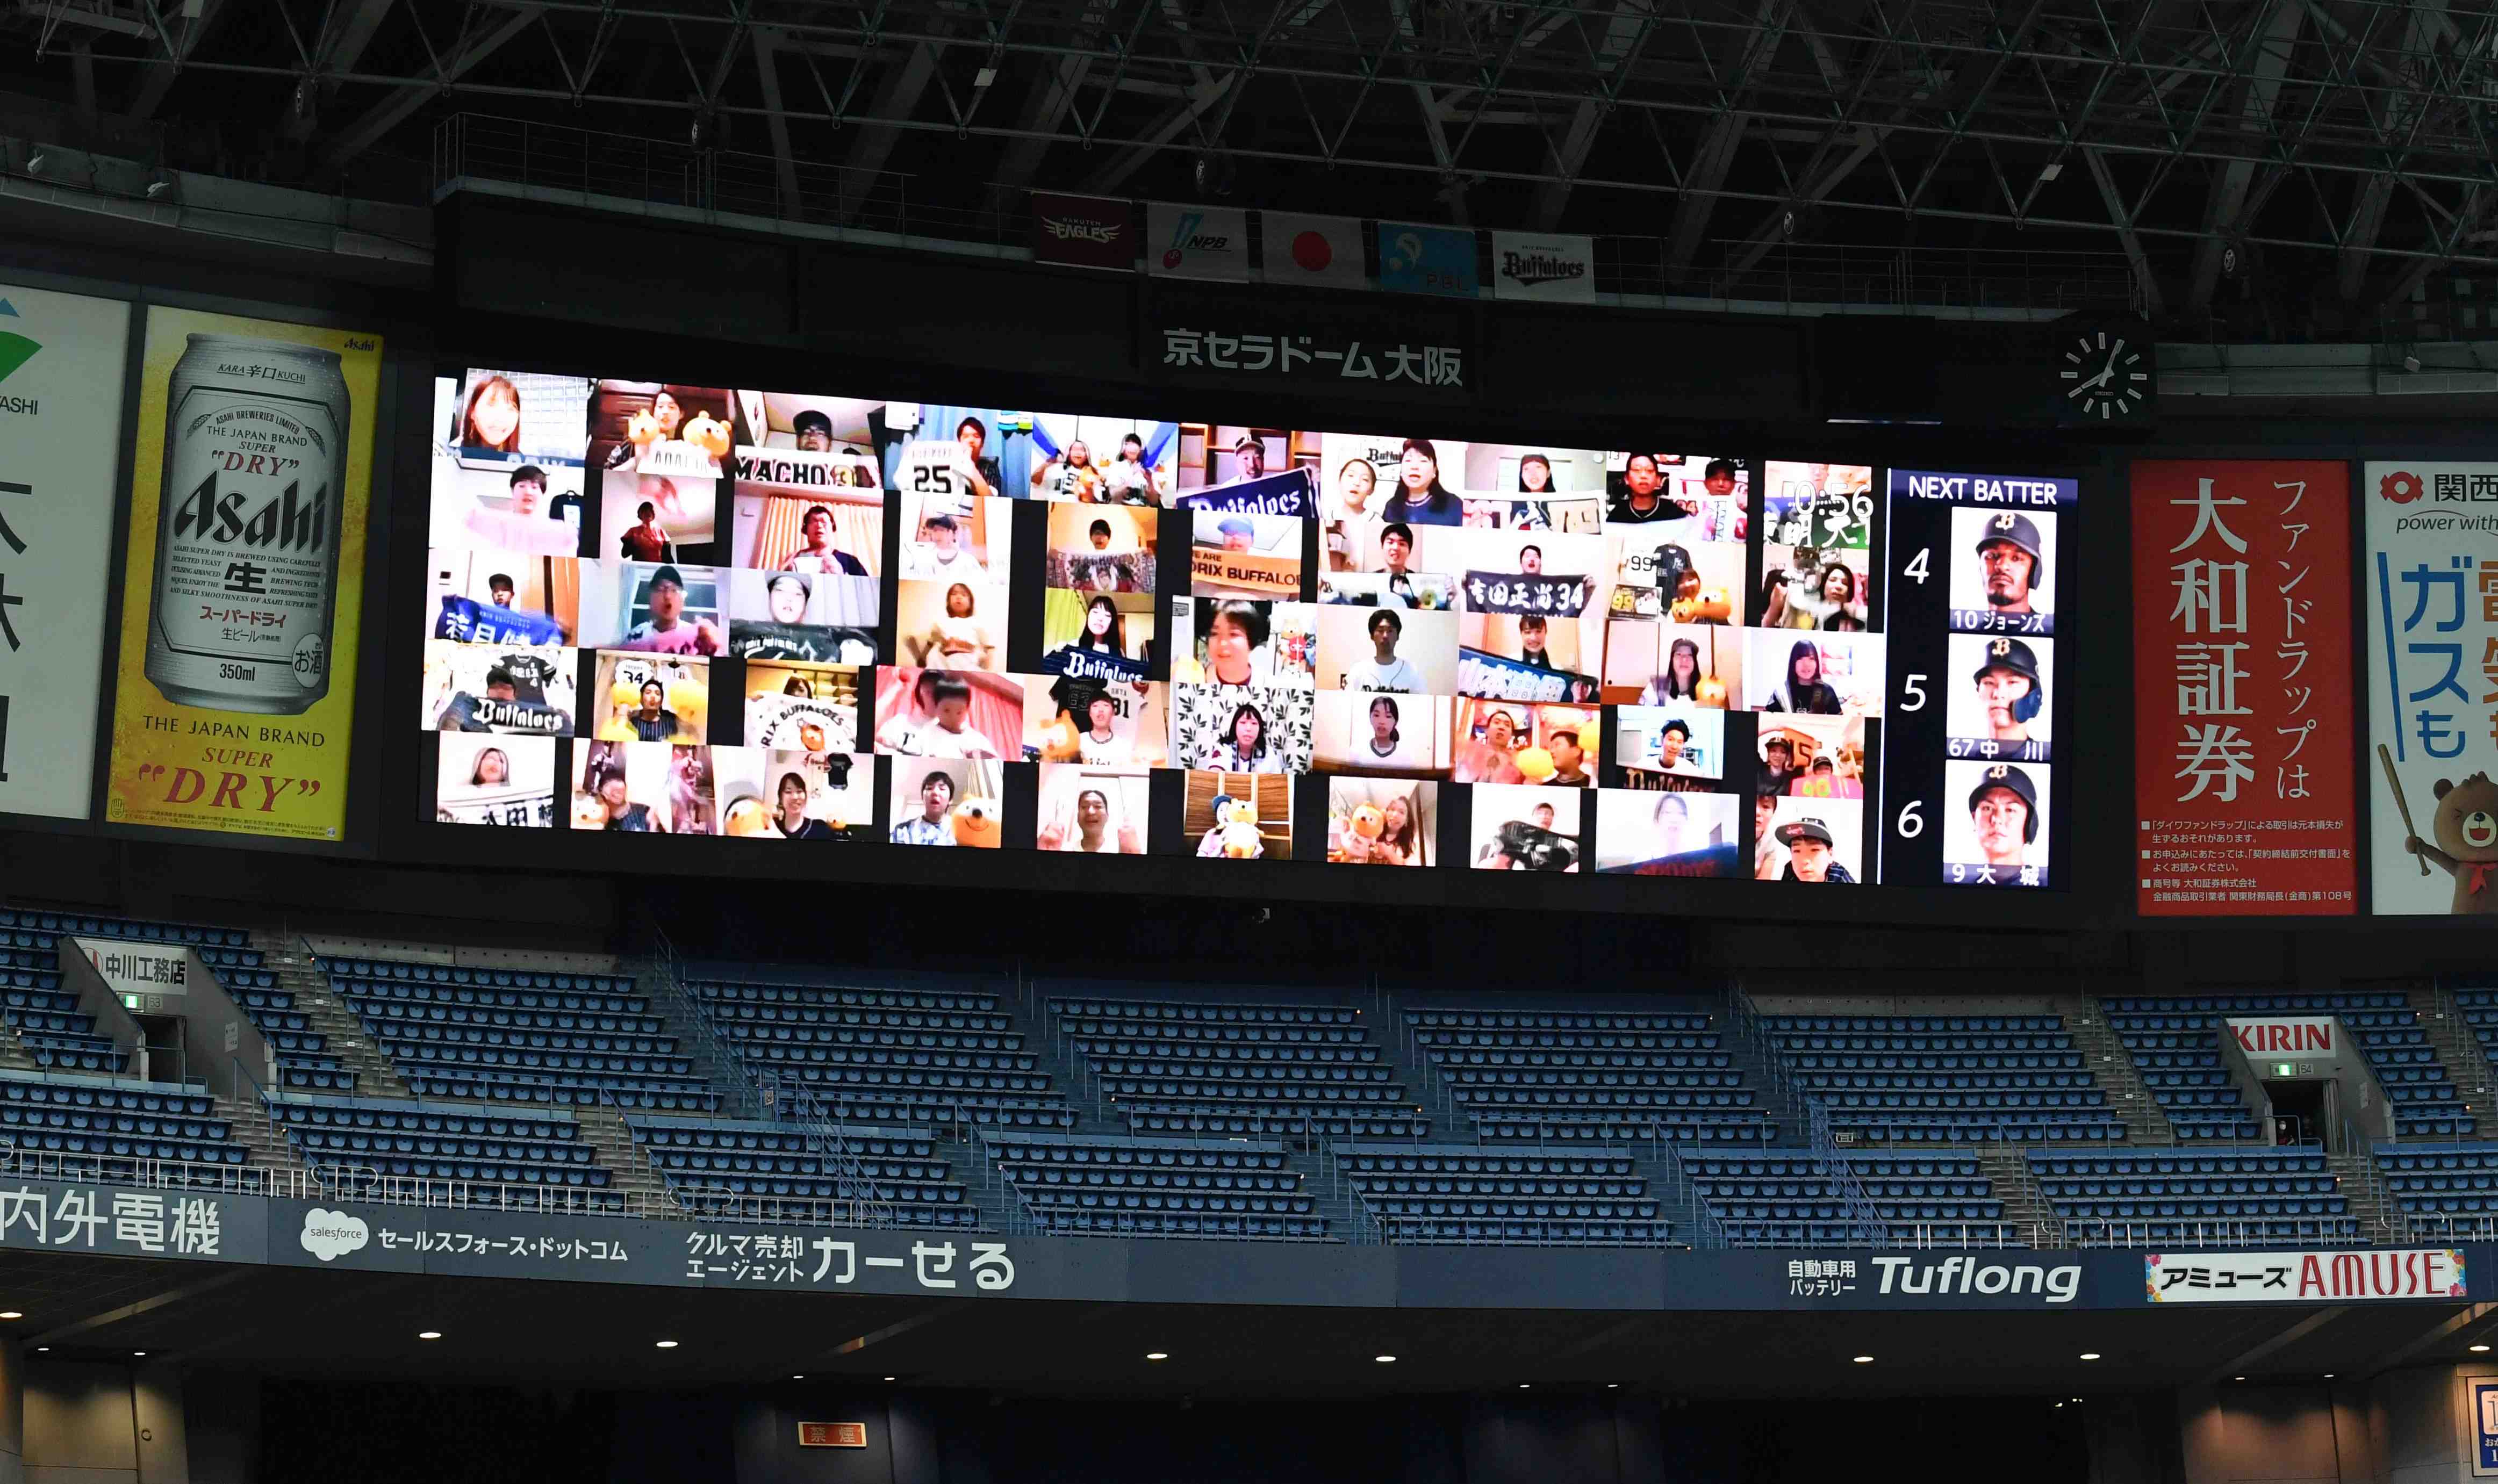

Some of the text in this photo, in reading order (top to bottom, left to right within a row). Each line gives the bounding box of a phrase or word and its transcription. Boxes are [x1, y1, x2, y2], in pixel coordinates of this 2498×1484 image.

[1055, 223, 1110, 242] EAGLES
[1187, 235, 1228, 249] NPB
[1502, 250, 1584, 284] Buffaloes
[344, 336, 375, 352] Asahi
[1163, 328, 1463, 388] 京セラドーム 大阪
[218, 363, 306, 382] KARA 辛口 KUCHI
[0, 395, 38, 415] ASHI
[216, 410, 300, 435] ASAHI BREWERIES LIMITED
[207, 426, 307, 446] THE JAPAN BRAND
[239, 441, 276, 453] SUPER
[914, 465, 951, 494] 25
[1909, 476, 2057, 505] NEXT BATTER
[2434, 474, 2498, 502] 関西
[175, 470, 327, 552] Asahi
[2395, 515, 2498, 534] power with
[190, 546, 210, 554] SUPER
[235, 553, 266, 561] BREWED
[268, 556, 288, 564] USING
[1203, 553, 1222, 562] ARE
[1631, 556, 1652, 571] 99
[1904, 548, 1929, 584] 4
[224, 561, 267, 594] 生
[201, 590, 249, 603] SMOOTHNESS
[250, 596, 262, 604] OF
[262, 598, 283, 607] ASAHI
[199, 606, 286, 628] スーパードライ
[1955, 610, 2045, 632] 10 ジョーンズ
[221, 628, 260, 643] 生ビール
[2170, 478, 2255, 802] 大和証券
[2274, 481, 2317, 799] ファンドラップは
[2401, 556, 2472, 758] ガスも
[219, 663, 256, 681] 350ml
[1900, 674, 1927, 711] 5
[142, 715, 326, 747] THE JAPAN BRAND
[202, 747, 274, 768] SUPER
[1949, 738, 1975, 757] 67
[1897, 800, 1923, 838] 6
[2152, 834, 2257, 844] 生ずるおそれがあります。
[1952, 863, 1965, 882] 9
[2153, 863, 2239, 873] よくお読みください。
[2184, 878, 2257, 888] 大和証券株式会社
[2153, 892, 2226, 902] 金融商品取引業者
[105, 953, 185, 985] 中川工務店
[2230, 1024, 2331, 1051] KIRIN
[0, 1186, 220, 1255] 内外電機
[310, 1227, 362, 1241] salesforce
[378, 1227, 628, 1262] セールスフォース・ドットコム
[686, 1231, 803, 1259] クルマ売却
[686, 1259, 804, 1283] エージェント
[813, 1236, 1015, 1290] カーせる
[1788, 1259, 1856, 1279] 自動車用
[1871, 1256, 2081, 1303] Tuflong
[2160, 1266, 2292, 1290] アミューズ
[2298, 1251, 2446, 1298] AMUSE
[1790, 1279, 1856, 1297] バッテリー
